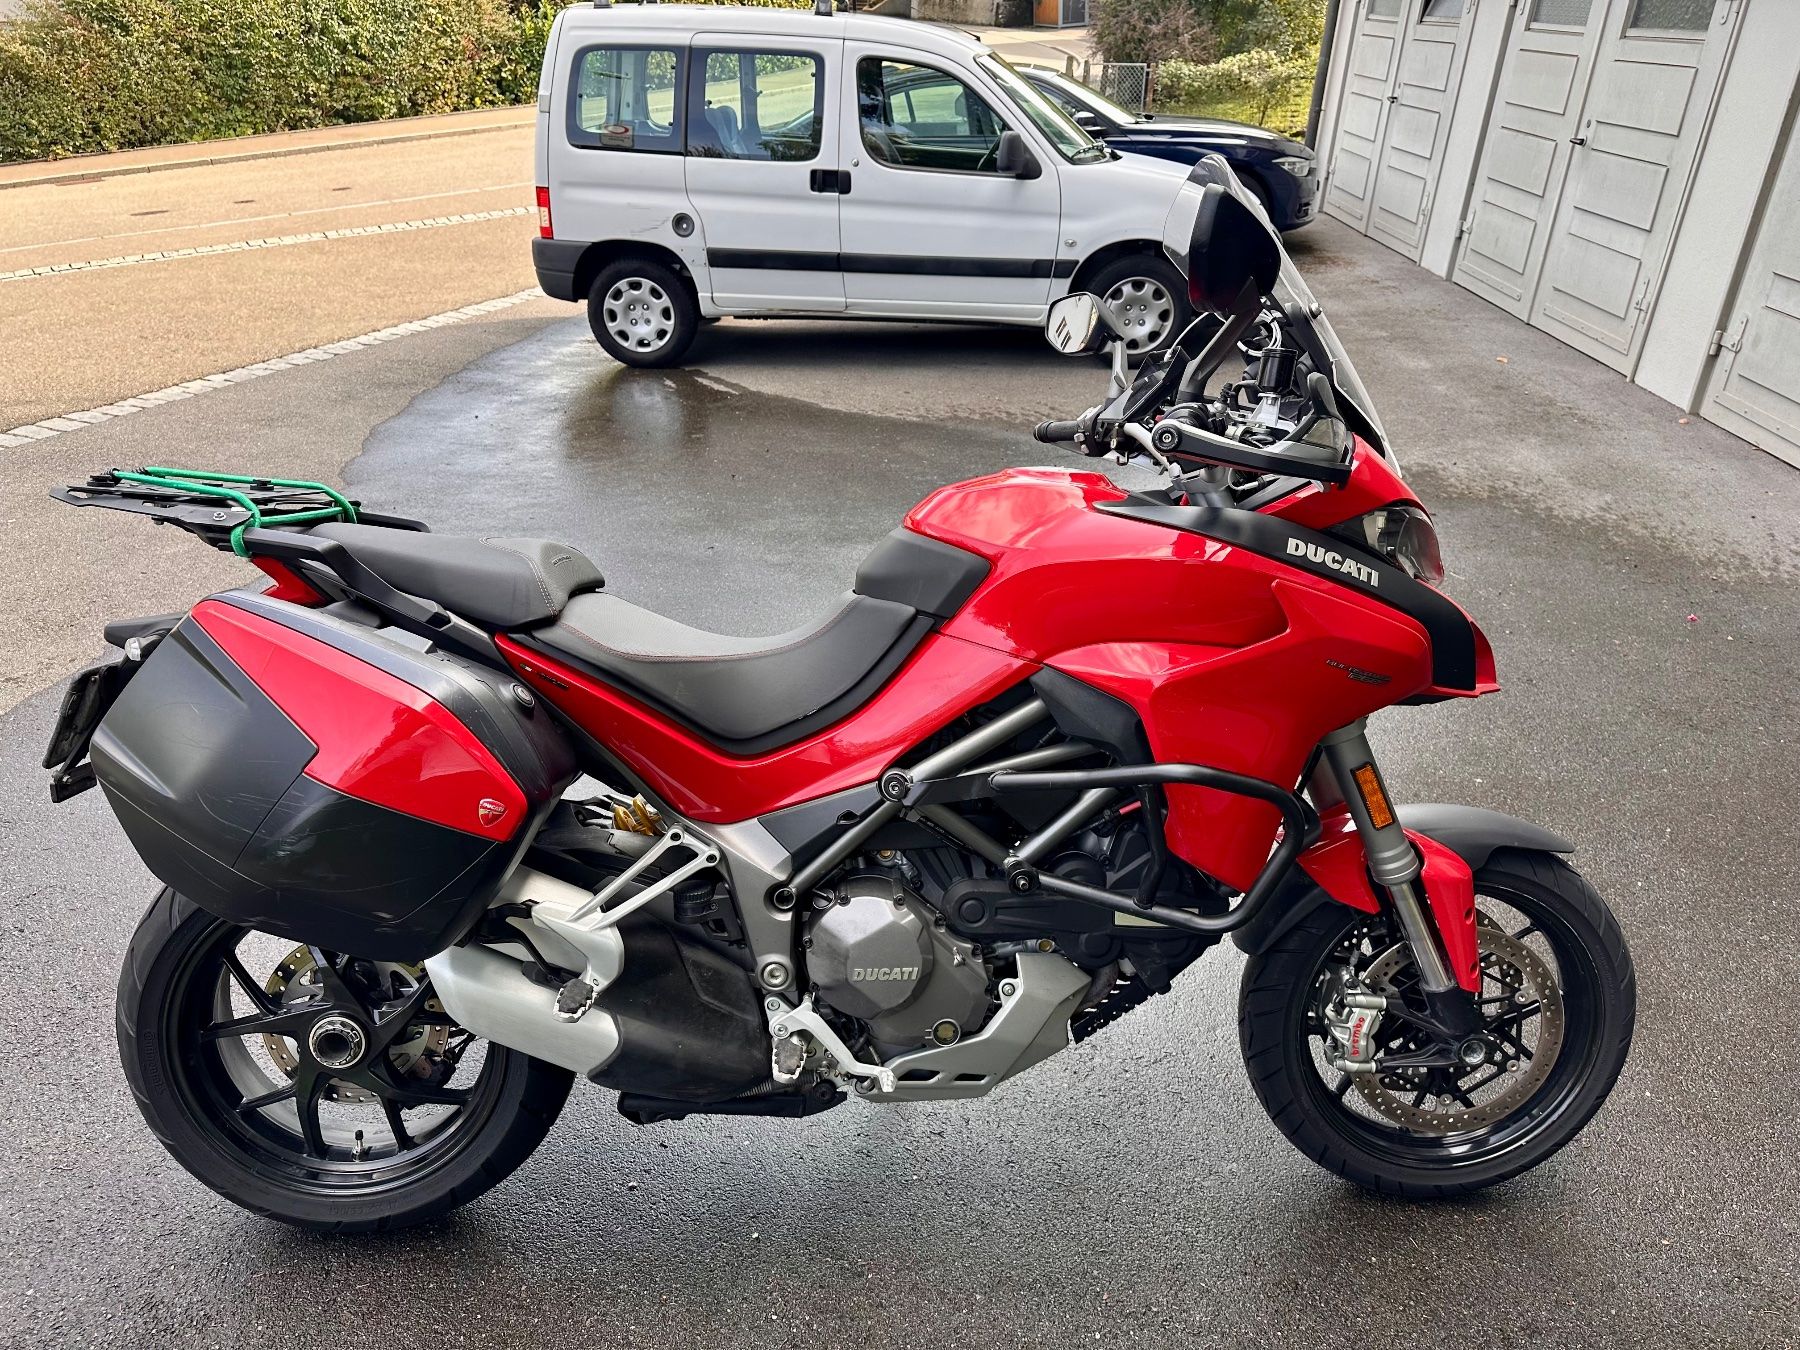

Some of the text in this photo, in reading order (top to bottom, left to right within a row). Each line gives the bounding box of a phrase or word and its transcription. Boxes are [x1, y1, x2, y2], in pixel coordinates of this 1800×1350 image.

[1286, 537, 1379, 587] DUCATI
[482, 802, 505, 812] DUCATI
[853, 967, 919, 981] DUCATI
[1351, 1016, 1365, 1056] brembo
